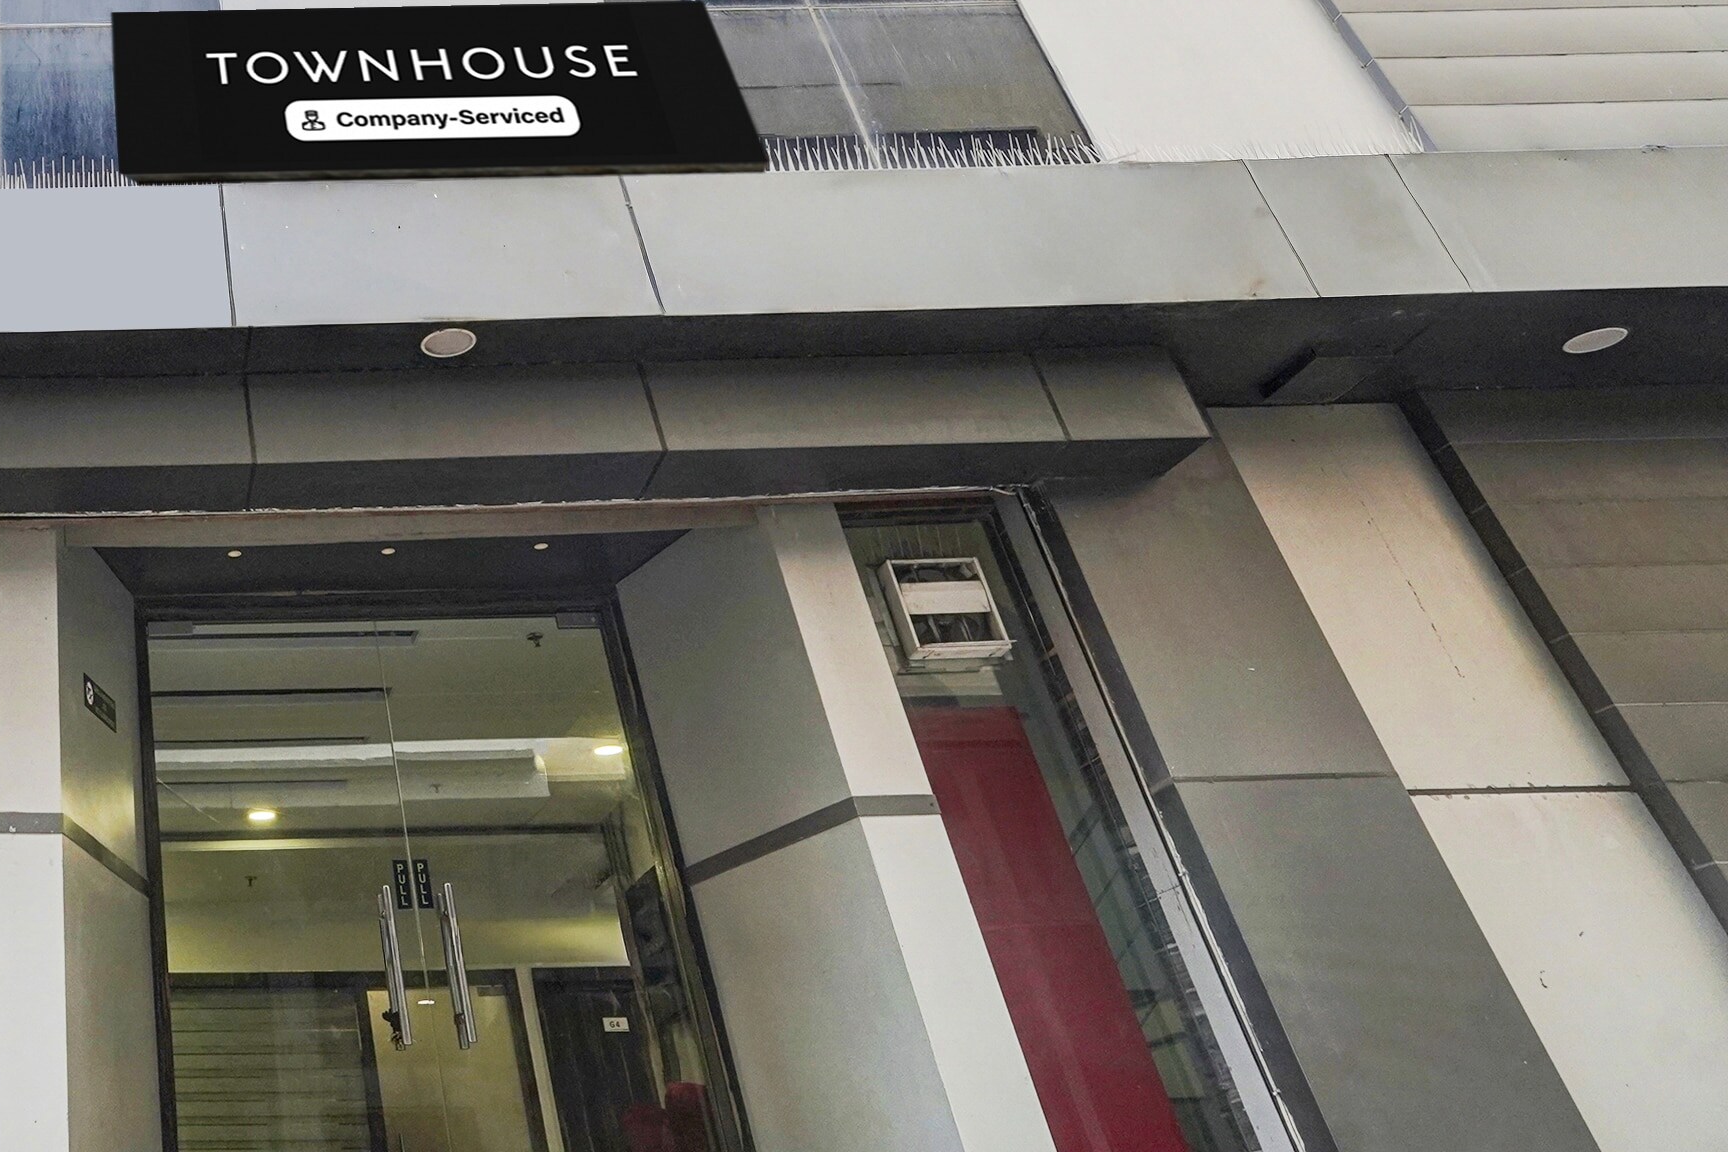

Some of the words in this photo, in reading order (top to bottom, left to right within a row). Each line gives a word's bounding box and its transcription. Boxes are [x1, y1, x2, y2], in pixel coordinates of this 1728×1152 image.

[205, 44, 638, 85] TOWNHOUSE
[336, 107, 565, 130] Company-Serviced
[396, 863, 408, 906] PULL
[416, 862, 429, 905] PULL
